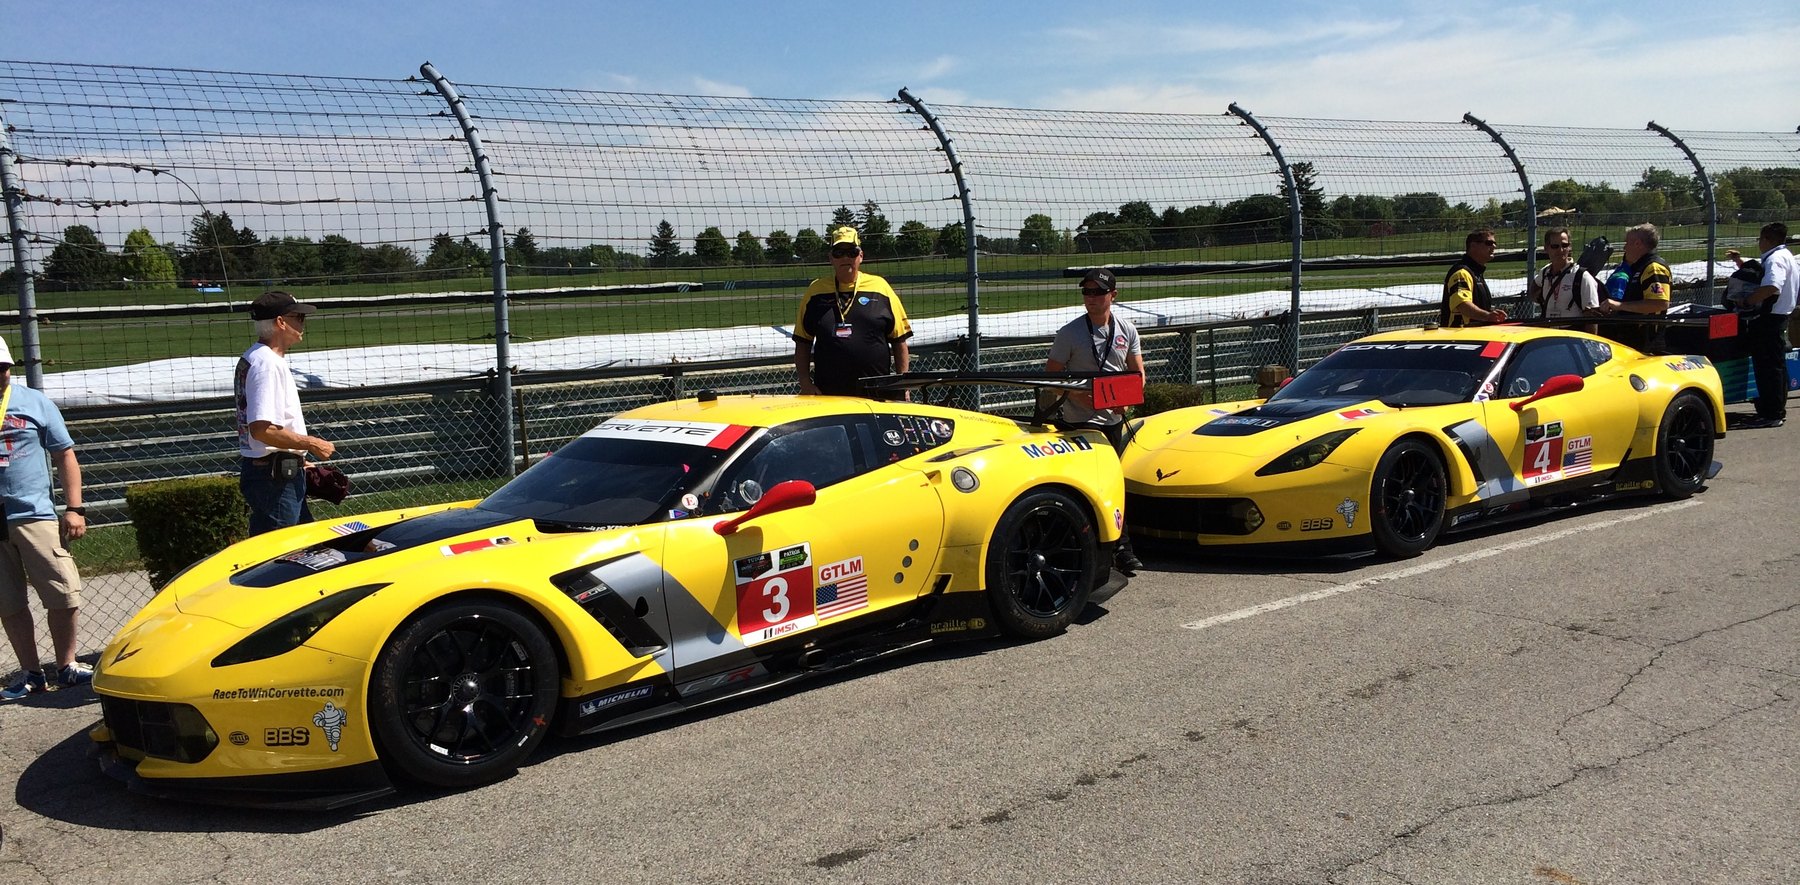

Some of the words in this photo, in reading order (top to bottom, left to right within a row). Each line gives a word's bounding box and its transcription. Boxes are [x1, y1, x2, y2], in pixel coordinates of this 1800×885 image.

[1341, 343, 1482, 351] CORVETTE
[1021, 438, 1075, 458] Mobil
[1568, 437, 1591, 450] GTLM
[1534, 441, 1551, 473] 4
[1300, 517, 1333, 531] BBS
[820, 559, 862, 581] GTLM
[762, 576, 790, 623] 3
[774, 622, 798, 636] IMSA
[213, 687, 344, 699] RaceToWinCorvette.com
[598, 687, 649, 707] MICHELIN
[264, 727, 310, 746] BBS
